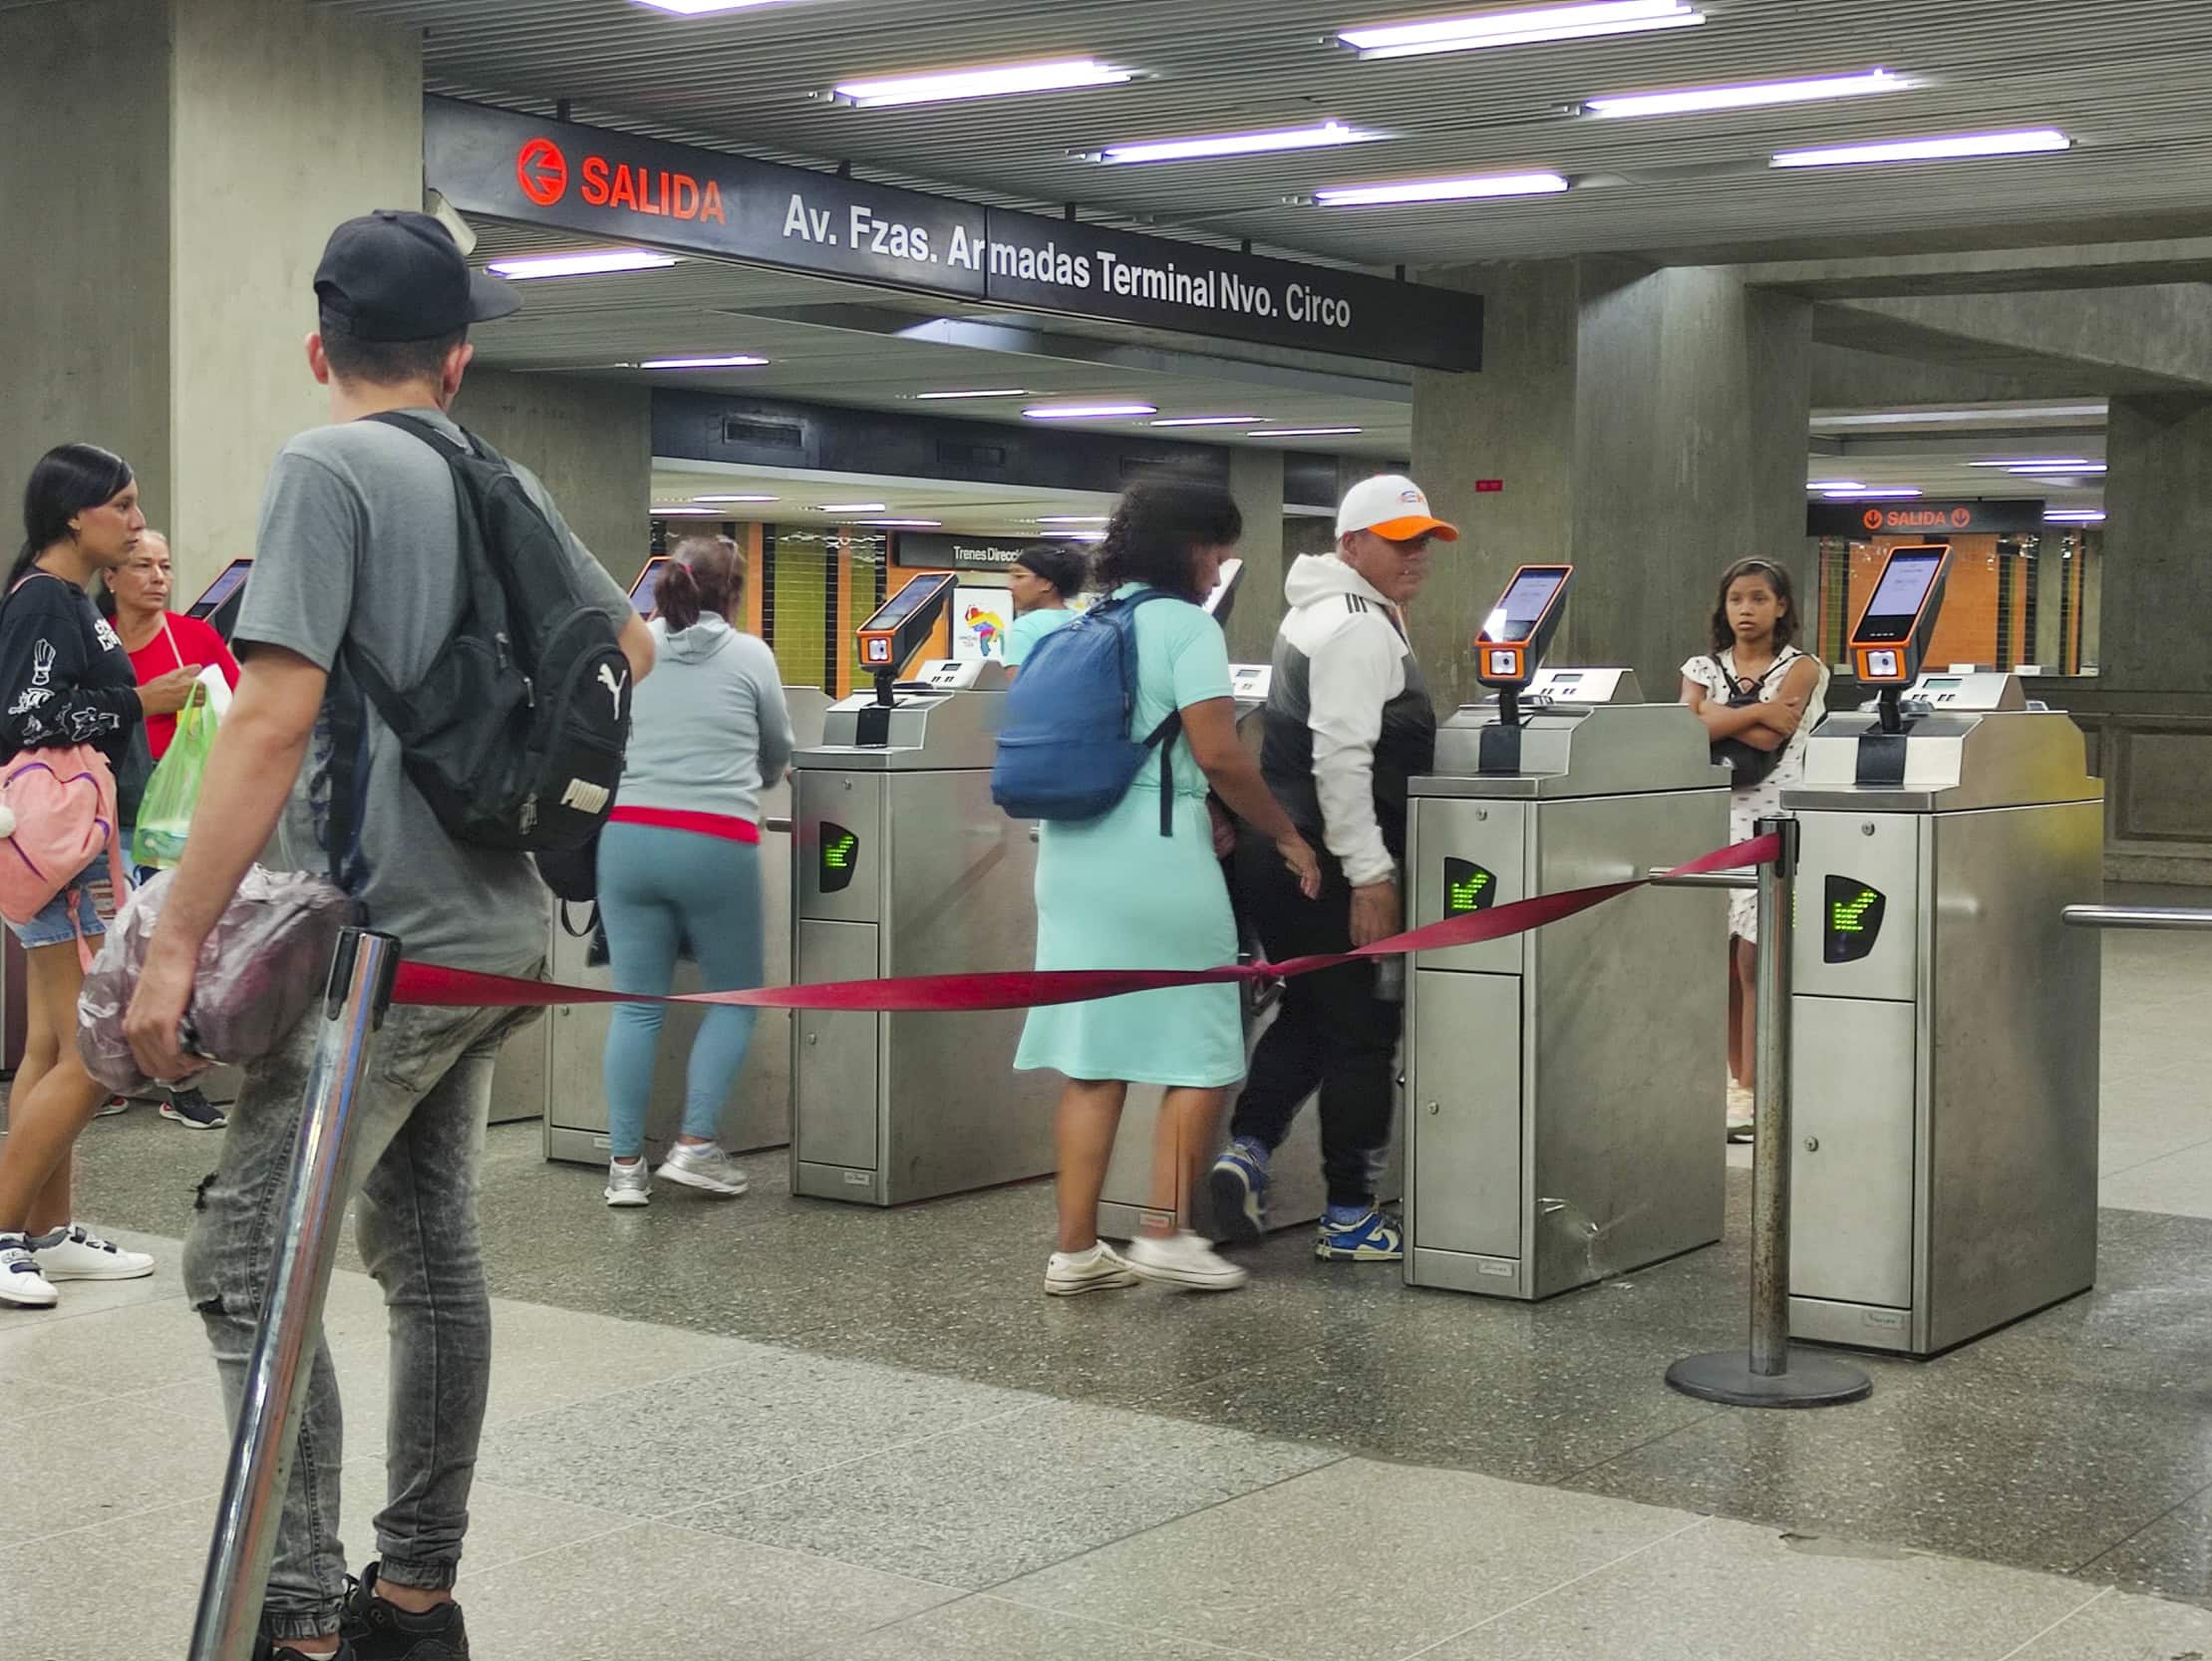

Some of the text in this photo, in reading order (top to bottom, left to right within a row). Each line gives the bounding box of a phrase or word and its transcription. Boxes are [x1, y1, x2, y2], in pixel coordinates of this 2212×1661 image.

[580, 156, 726, 225] SALIDA
[783, 194, 1351, 328] Av. Fzas. Armadas Terminal Nvo. Circo
[1886, 510, 1946, 527] SALIDA
[953, 545, 987, 561] Trenes
